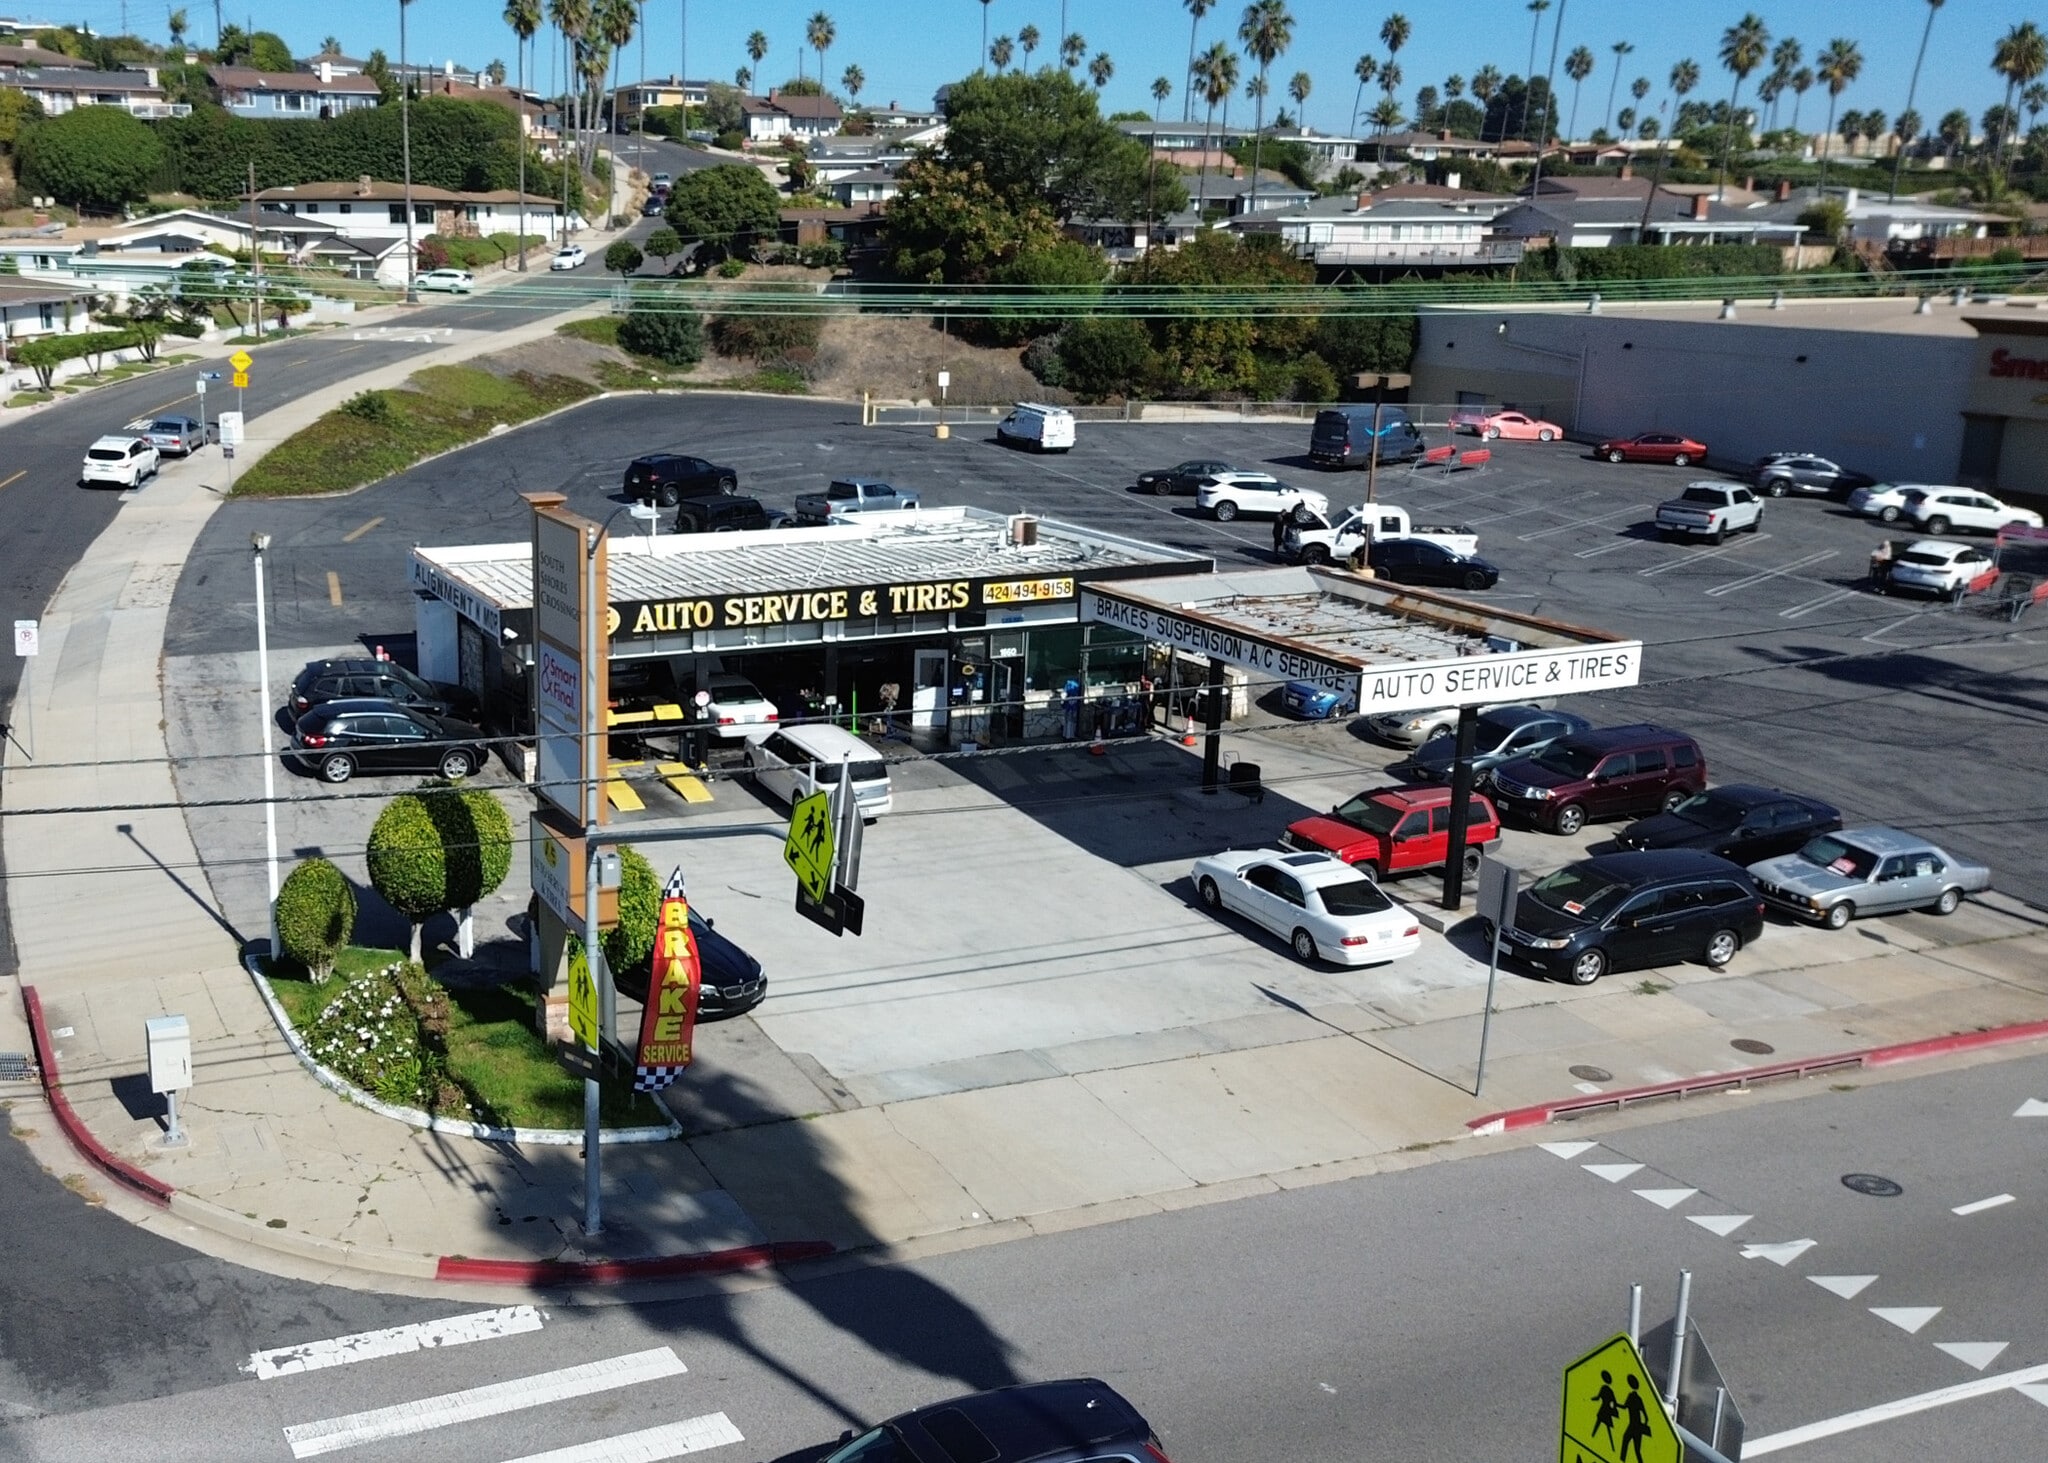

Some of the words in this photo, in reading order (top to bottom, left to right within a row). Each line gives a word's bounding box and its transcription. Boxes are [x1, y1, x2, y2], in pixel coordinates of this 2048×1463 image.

[541, 551, 564, 573] SOUTH
[415, 563, 473, 616] ALIGNMENT
[541, 571, 567, 595] SHORES
[540, 591, 577, 619] CROSSING
[632, 601, 714, 633] AUTO
[724, 591, 848, 626] SERVICE
[859, 590, 878, 616] &
[889, 582, 970, 614] TIRES
[1097, 597, 1148, 630] BRAKES
[1156, 616, 1242, 660] SUSPENSION
[1249, 646, 1274, 668] A/C
[1279, 653, 1346, 692] SERVICE
[551, 658, 576, 689] Smart
[1372, 673, 1435, 700] AUTO
[1445, 662, 1539, 693] SERVICE
[1545, 661, 1561, 683] &
[1567, 654, 1629, 680] TIRES
[654, 902, 691, 1042] BRAKE
[643, 1043, 690, 1064] SERVICE
